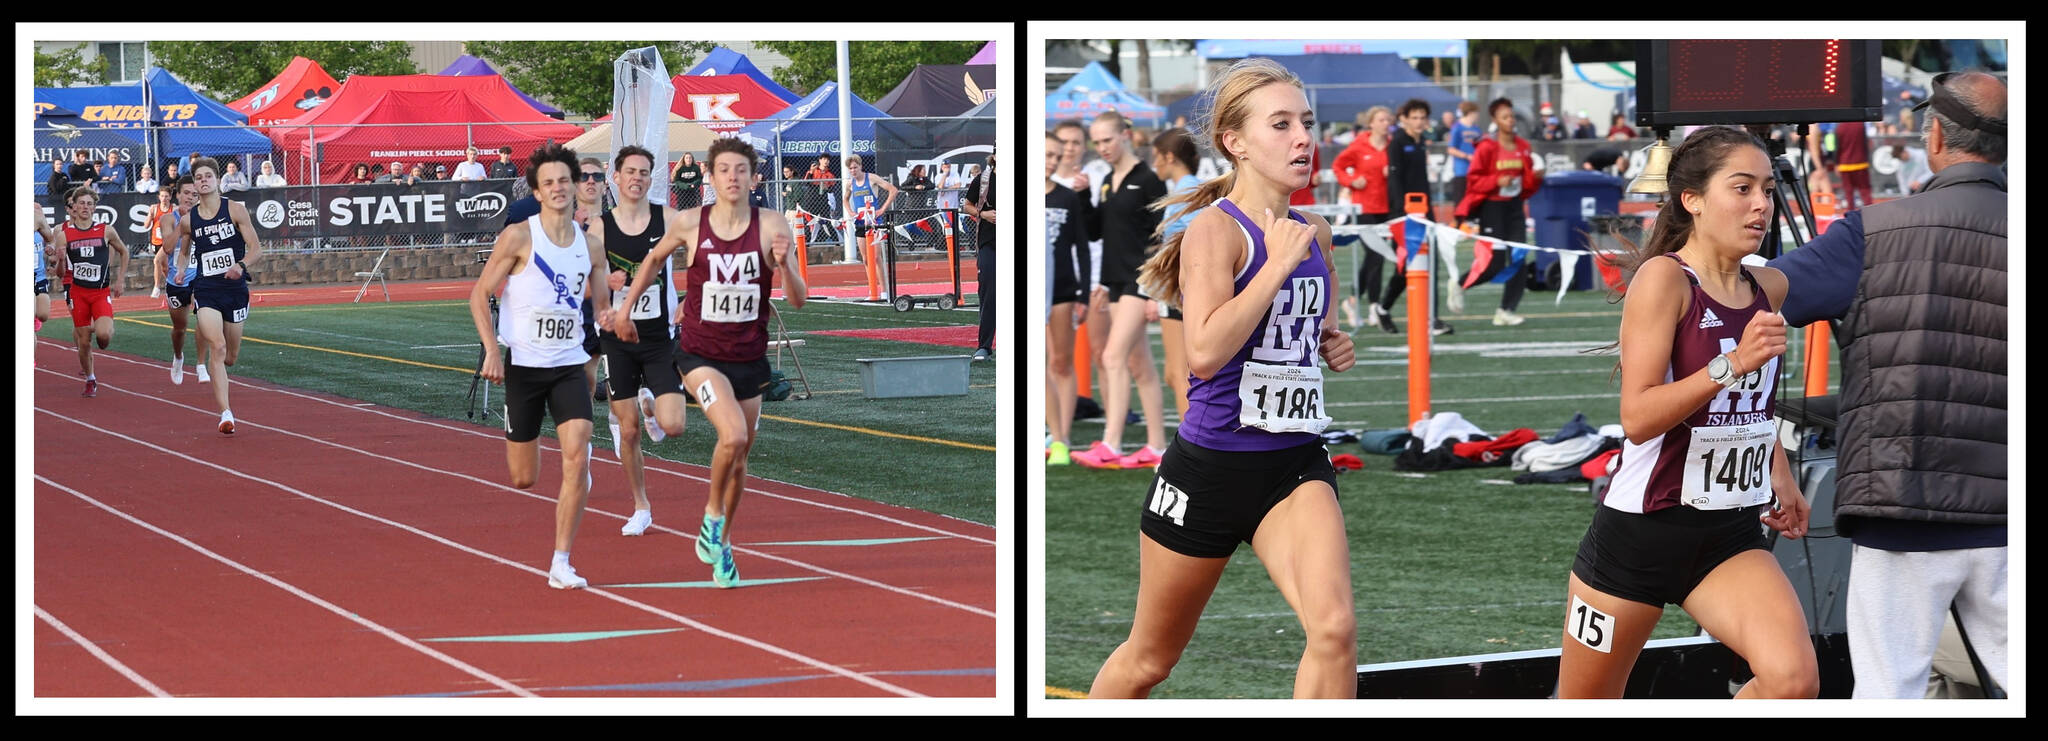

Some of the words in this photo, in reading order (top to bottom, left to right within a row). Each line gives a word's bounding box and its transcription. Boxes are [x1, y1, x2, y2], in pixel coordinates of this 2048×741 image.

[81, 104, 198, 121] KNIGTS
[781, 140, 827, 152] LIBERTY
[288, 200, 312, 209] Gesa
[288, 208, 318, 218] Credit
[329, 193, 446, 226] STATE
[464, 199, 499, 211] WIAA
[289, 217, 316, 226] Union
[222, 226, 233, 238] 14
[84, 247, 92, 256] 12
[76, 265, 97, 277] 2201
[206, 254, 232, 272] 1499
[744, 256, 756, 277] 4
[574, 272, 585, 295] 3
[710, 294, 754, 315] 1414
[1299, 279, 1318, 315] 12
[236, 309, 245, 319] 14
[536, 317, 574, 340] 1962
[701, 386, 711, 404] 4
[1705, 411, 1768, 426] ISLANDERS
[1700, 442, 1766, 492] 1409
[1577, 604, 1605, 647] 15
